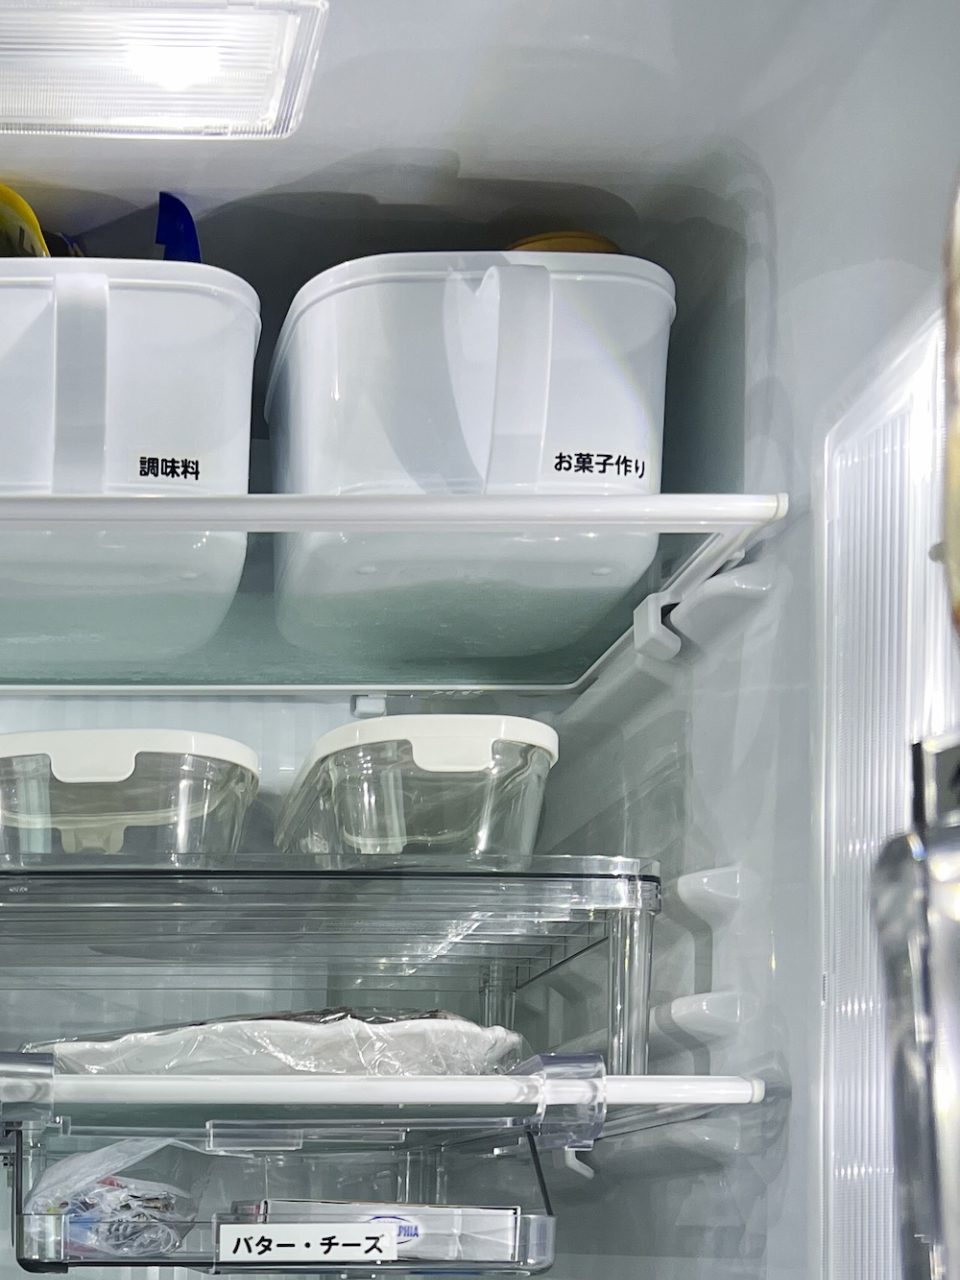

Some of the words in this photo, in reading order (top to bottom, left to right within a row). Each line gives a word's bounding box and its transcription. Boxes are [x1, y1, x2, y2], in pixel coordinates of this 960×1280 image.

[139, 456, 200, 480] 調味料
[554, 452, 645, 479] お菓子作り
[232, 1234, 385, 1256] バター・チーズ
